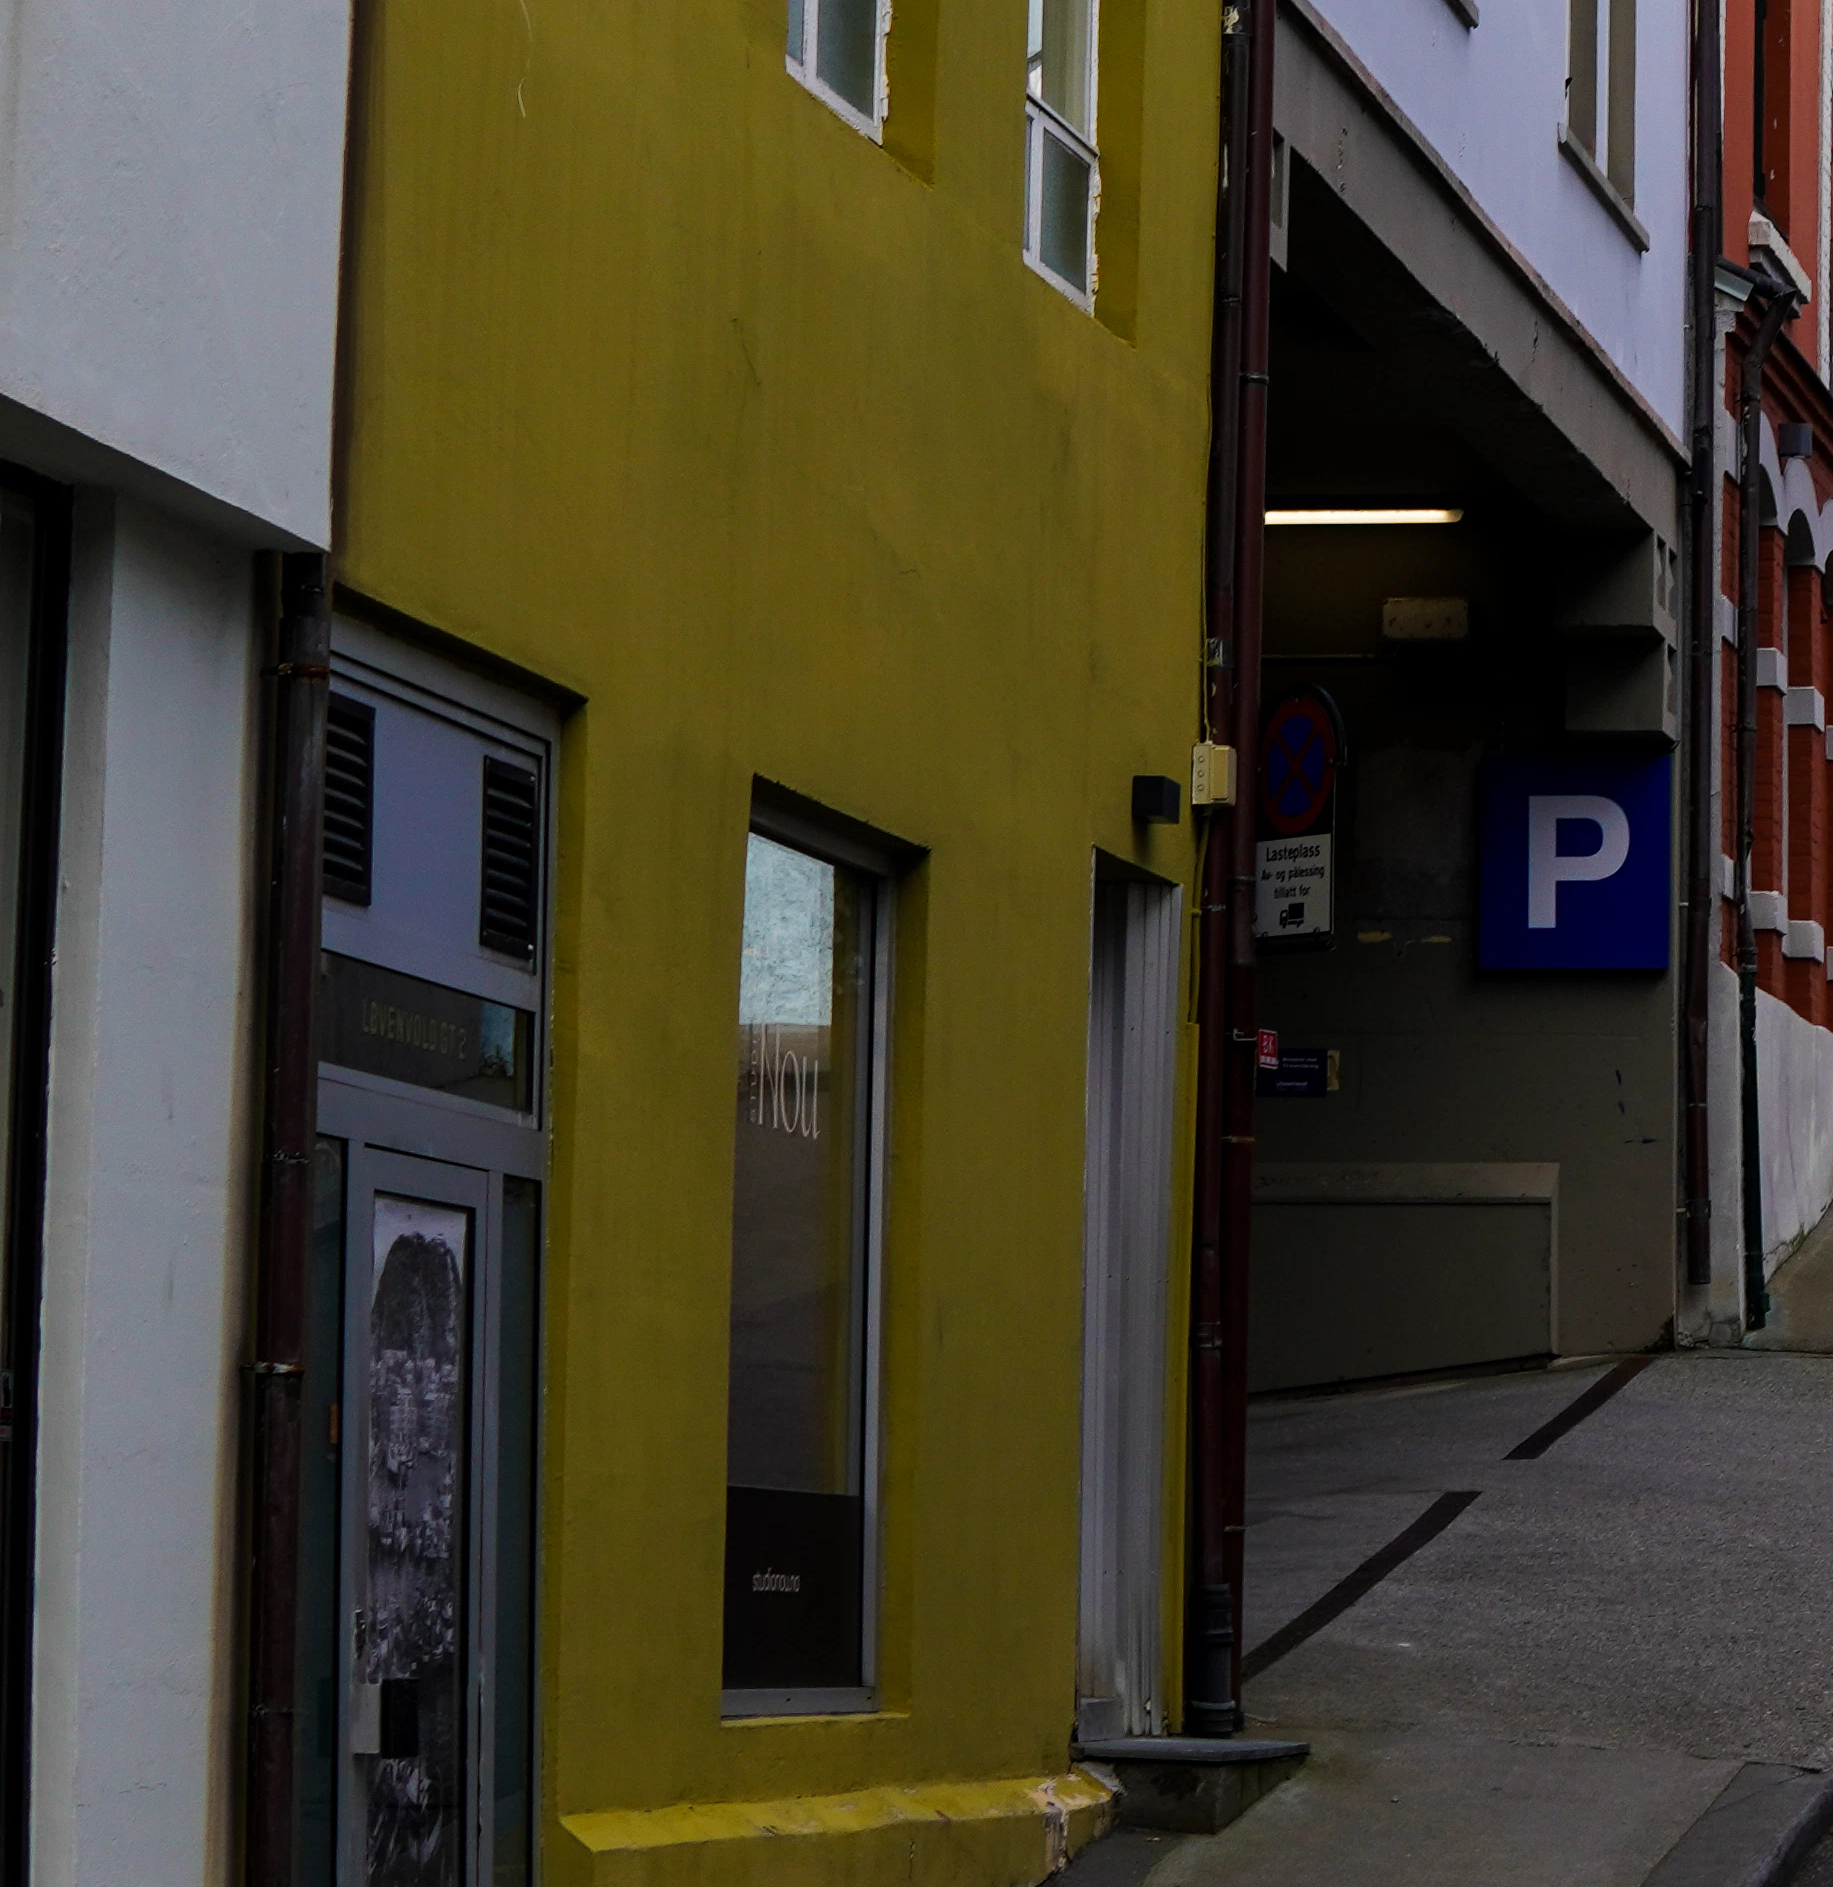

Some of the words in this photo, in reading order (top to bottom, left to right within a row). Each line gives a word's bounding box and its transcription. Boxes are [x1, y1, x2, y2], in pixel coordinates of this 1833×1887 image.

[1266, 844, 1321, 862] Lasteplass
[1528, 794, 1630, 929] P
[1276, 870, 1285, 882] og
[1274, 885, 1297, 899] tillatt
[1299, 884, 1311, 897] for
[459, 1026, 467, 1060] 2
